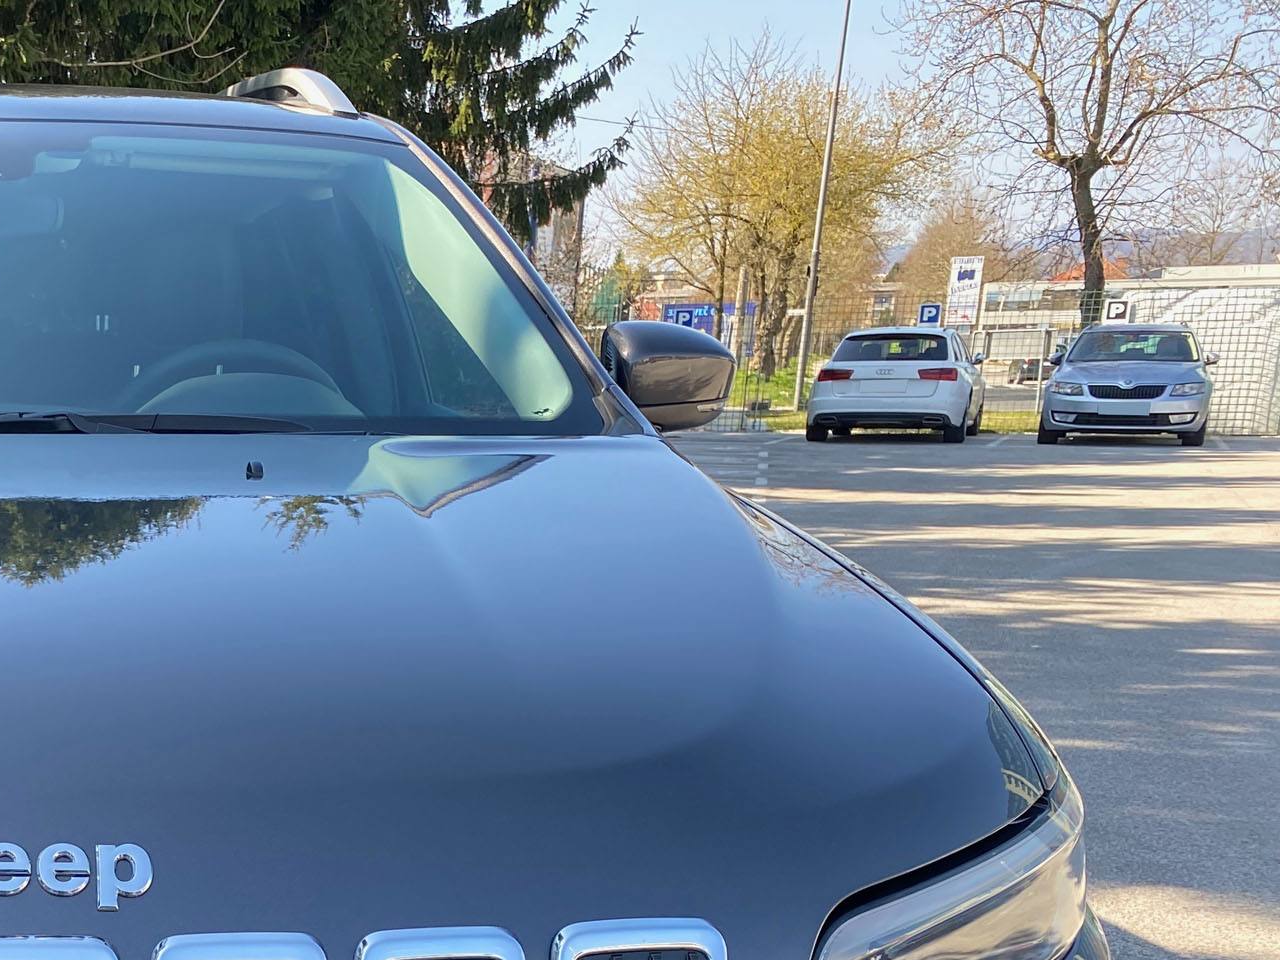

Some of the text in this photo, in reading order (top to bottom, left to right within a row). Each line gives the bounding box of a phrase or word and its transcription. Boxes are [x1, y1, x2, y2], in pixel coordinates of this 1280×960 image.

[922, 307, 937, 321] P
[1109, 303, 1125, 318] P
[679, 312, 691, 327] P
